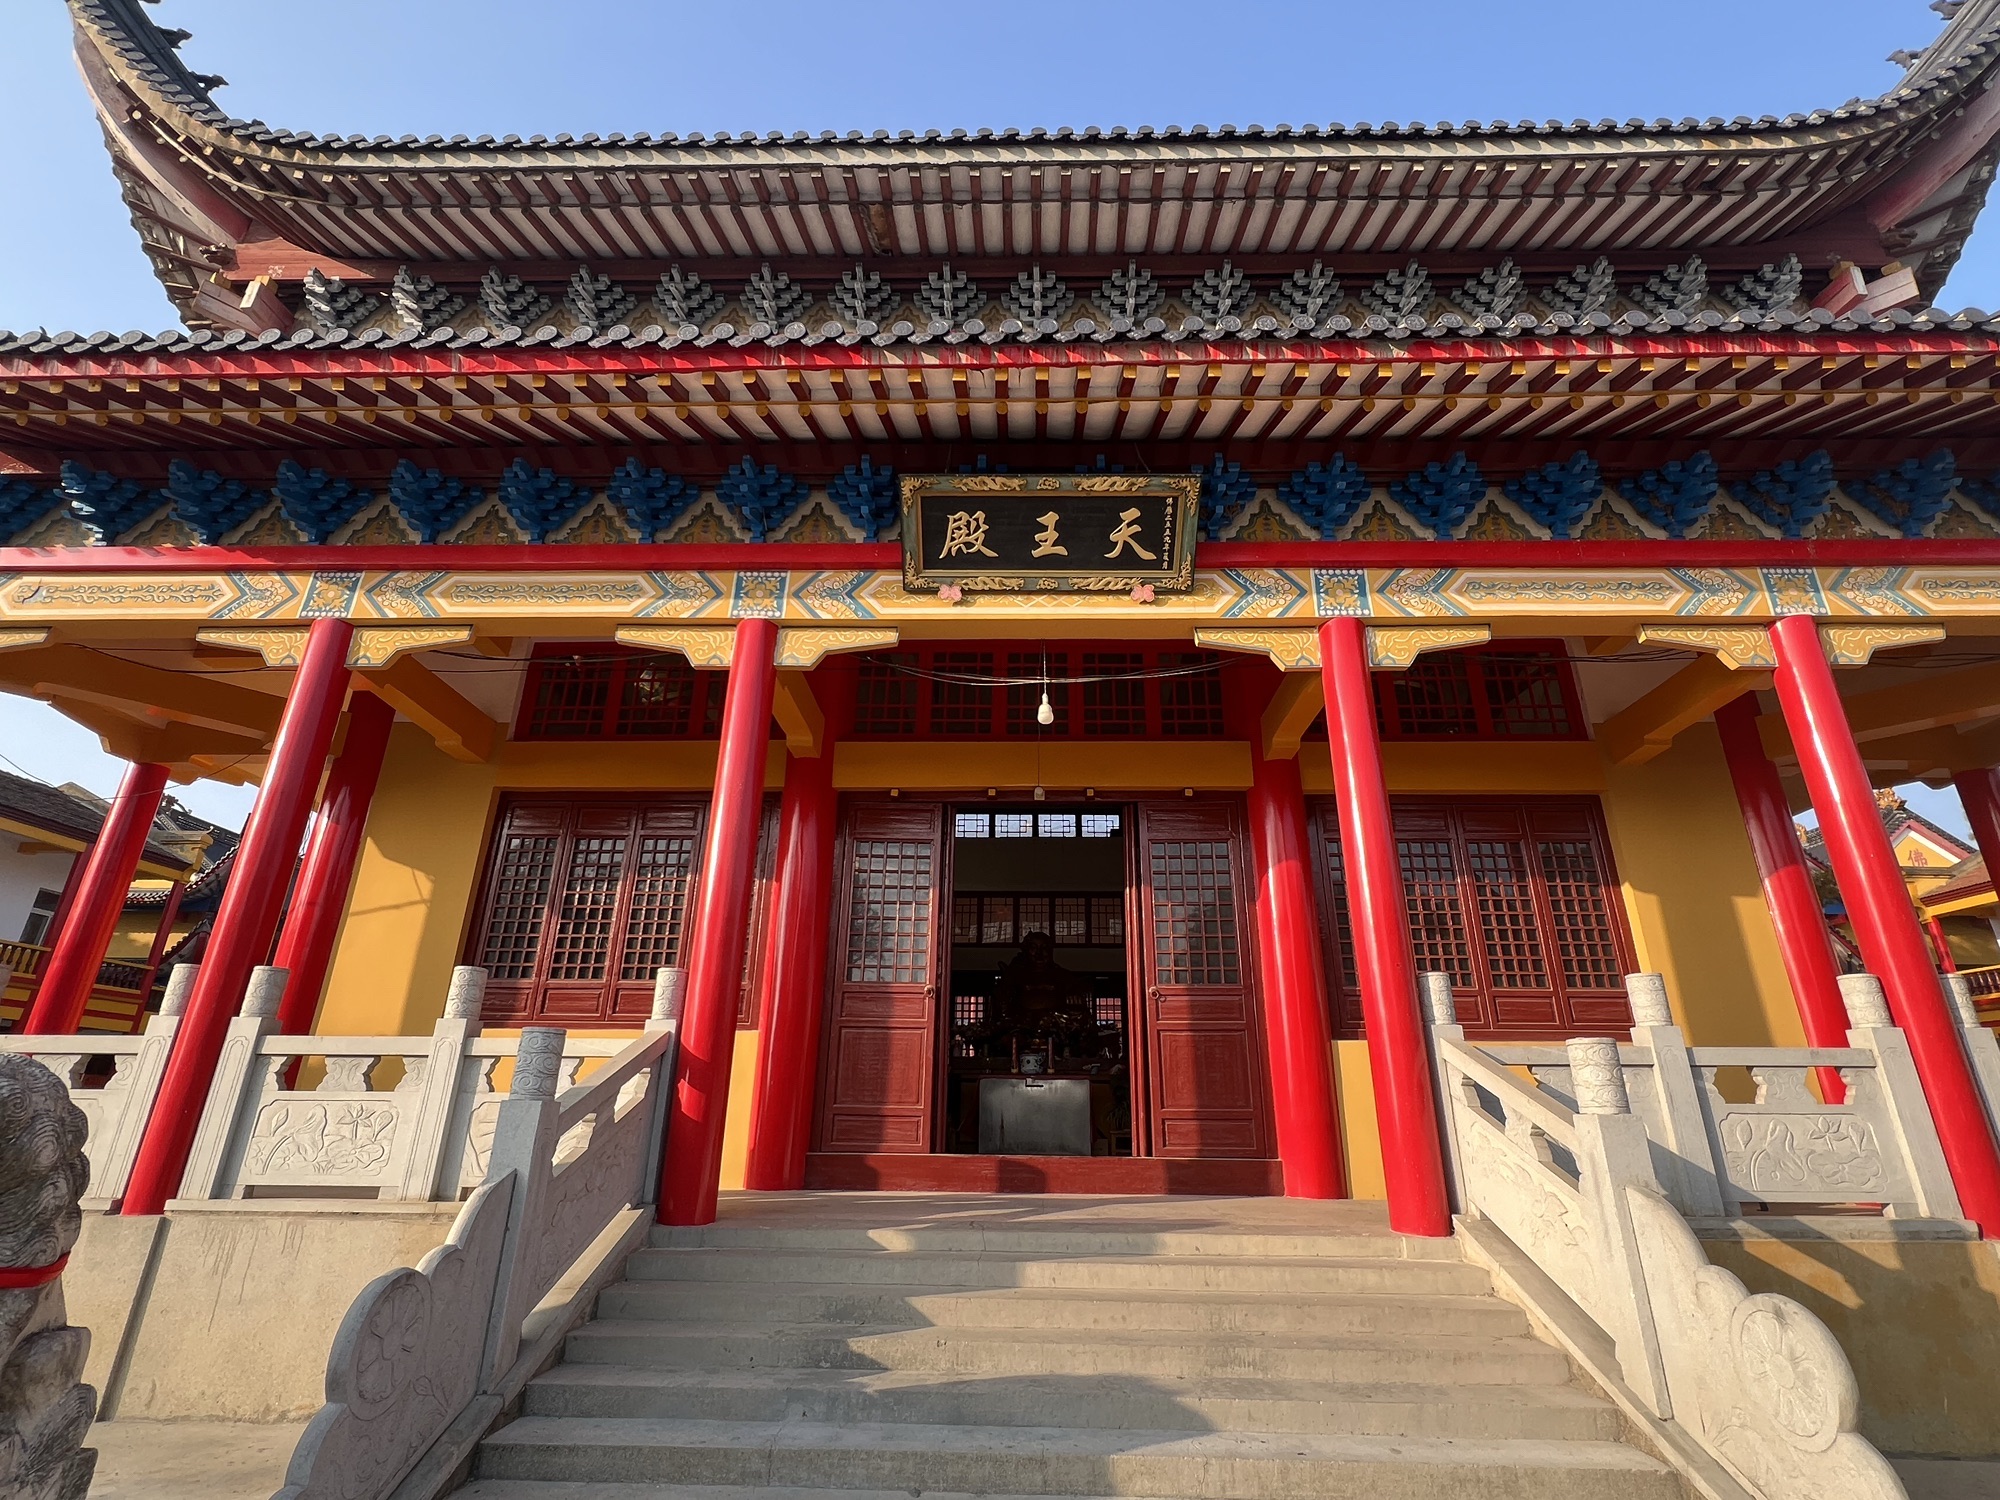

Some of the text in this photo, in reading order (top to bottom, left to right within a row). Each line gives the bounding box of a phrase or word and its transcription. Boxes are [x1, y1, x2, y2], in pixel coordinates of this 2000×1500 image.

[938, 507, 1157, 560] 天王殿
[1907, 848, 1928, 867] 佛
